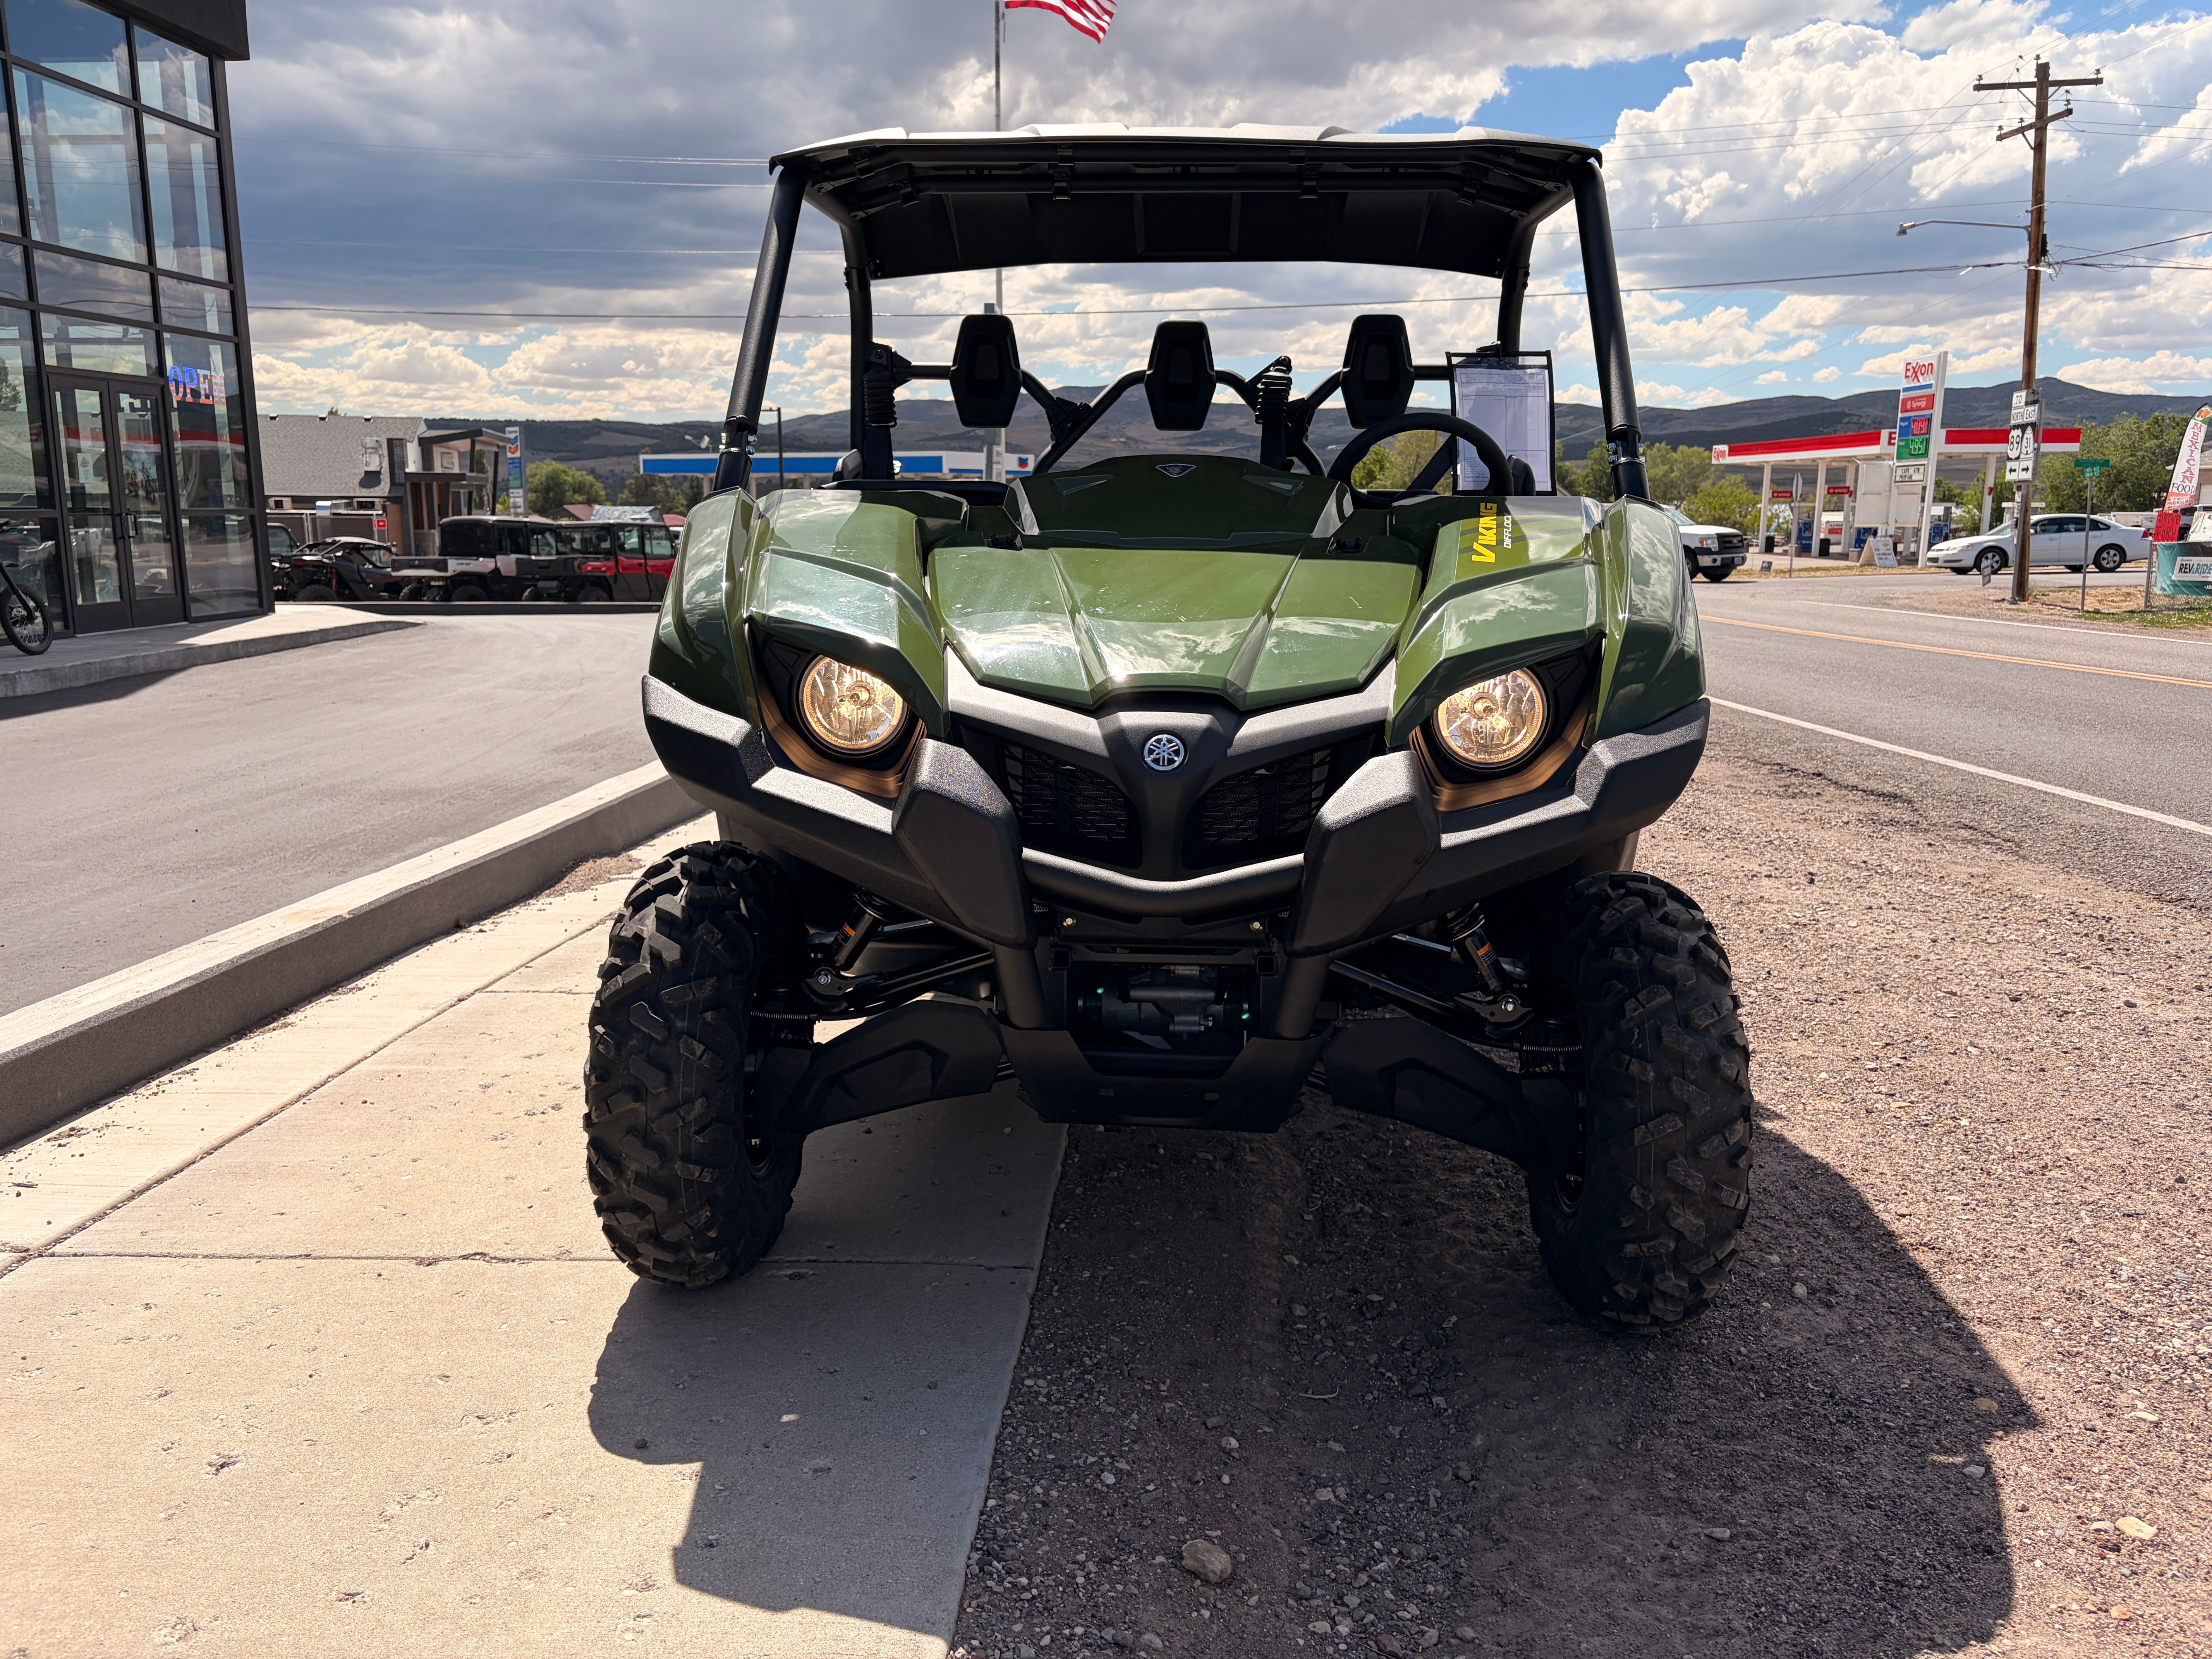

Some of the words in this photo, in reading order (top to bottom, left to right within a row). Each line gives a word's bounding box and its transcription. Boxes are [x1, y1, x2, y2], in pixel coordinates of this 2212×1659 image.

[1905, 361, 1934, 383] Exxon
[168, 366, 226, 406] OPEN
[2016, 395, 2022, 404] TO
[2011, 411, 2023, 421] NORTH
[2025, 409, 2036, 419] EAST
[2009, 434, 2020, 452] 89
[2025, 437, 2031, 449] 31
[2180, 422, 2203, 484] MEXICAN
[2171, 483, 2195, 495] FOOD
[2159, 514, 2180, 525] DRIVE
[1472, 502, 1497, 563] VIKING
